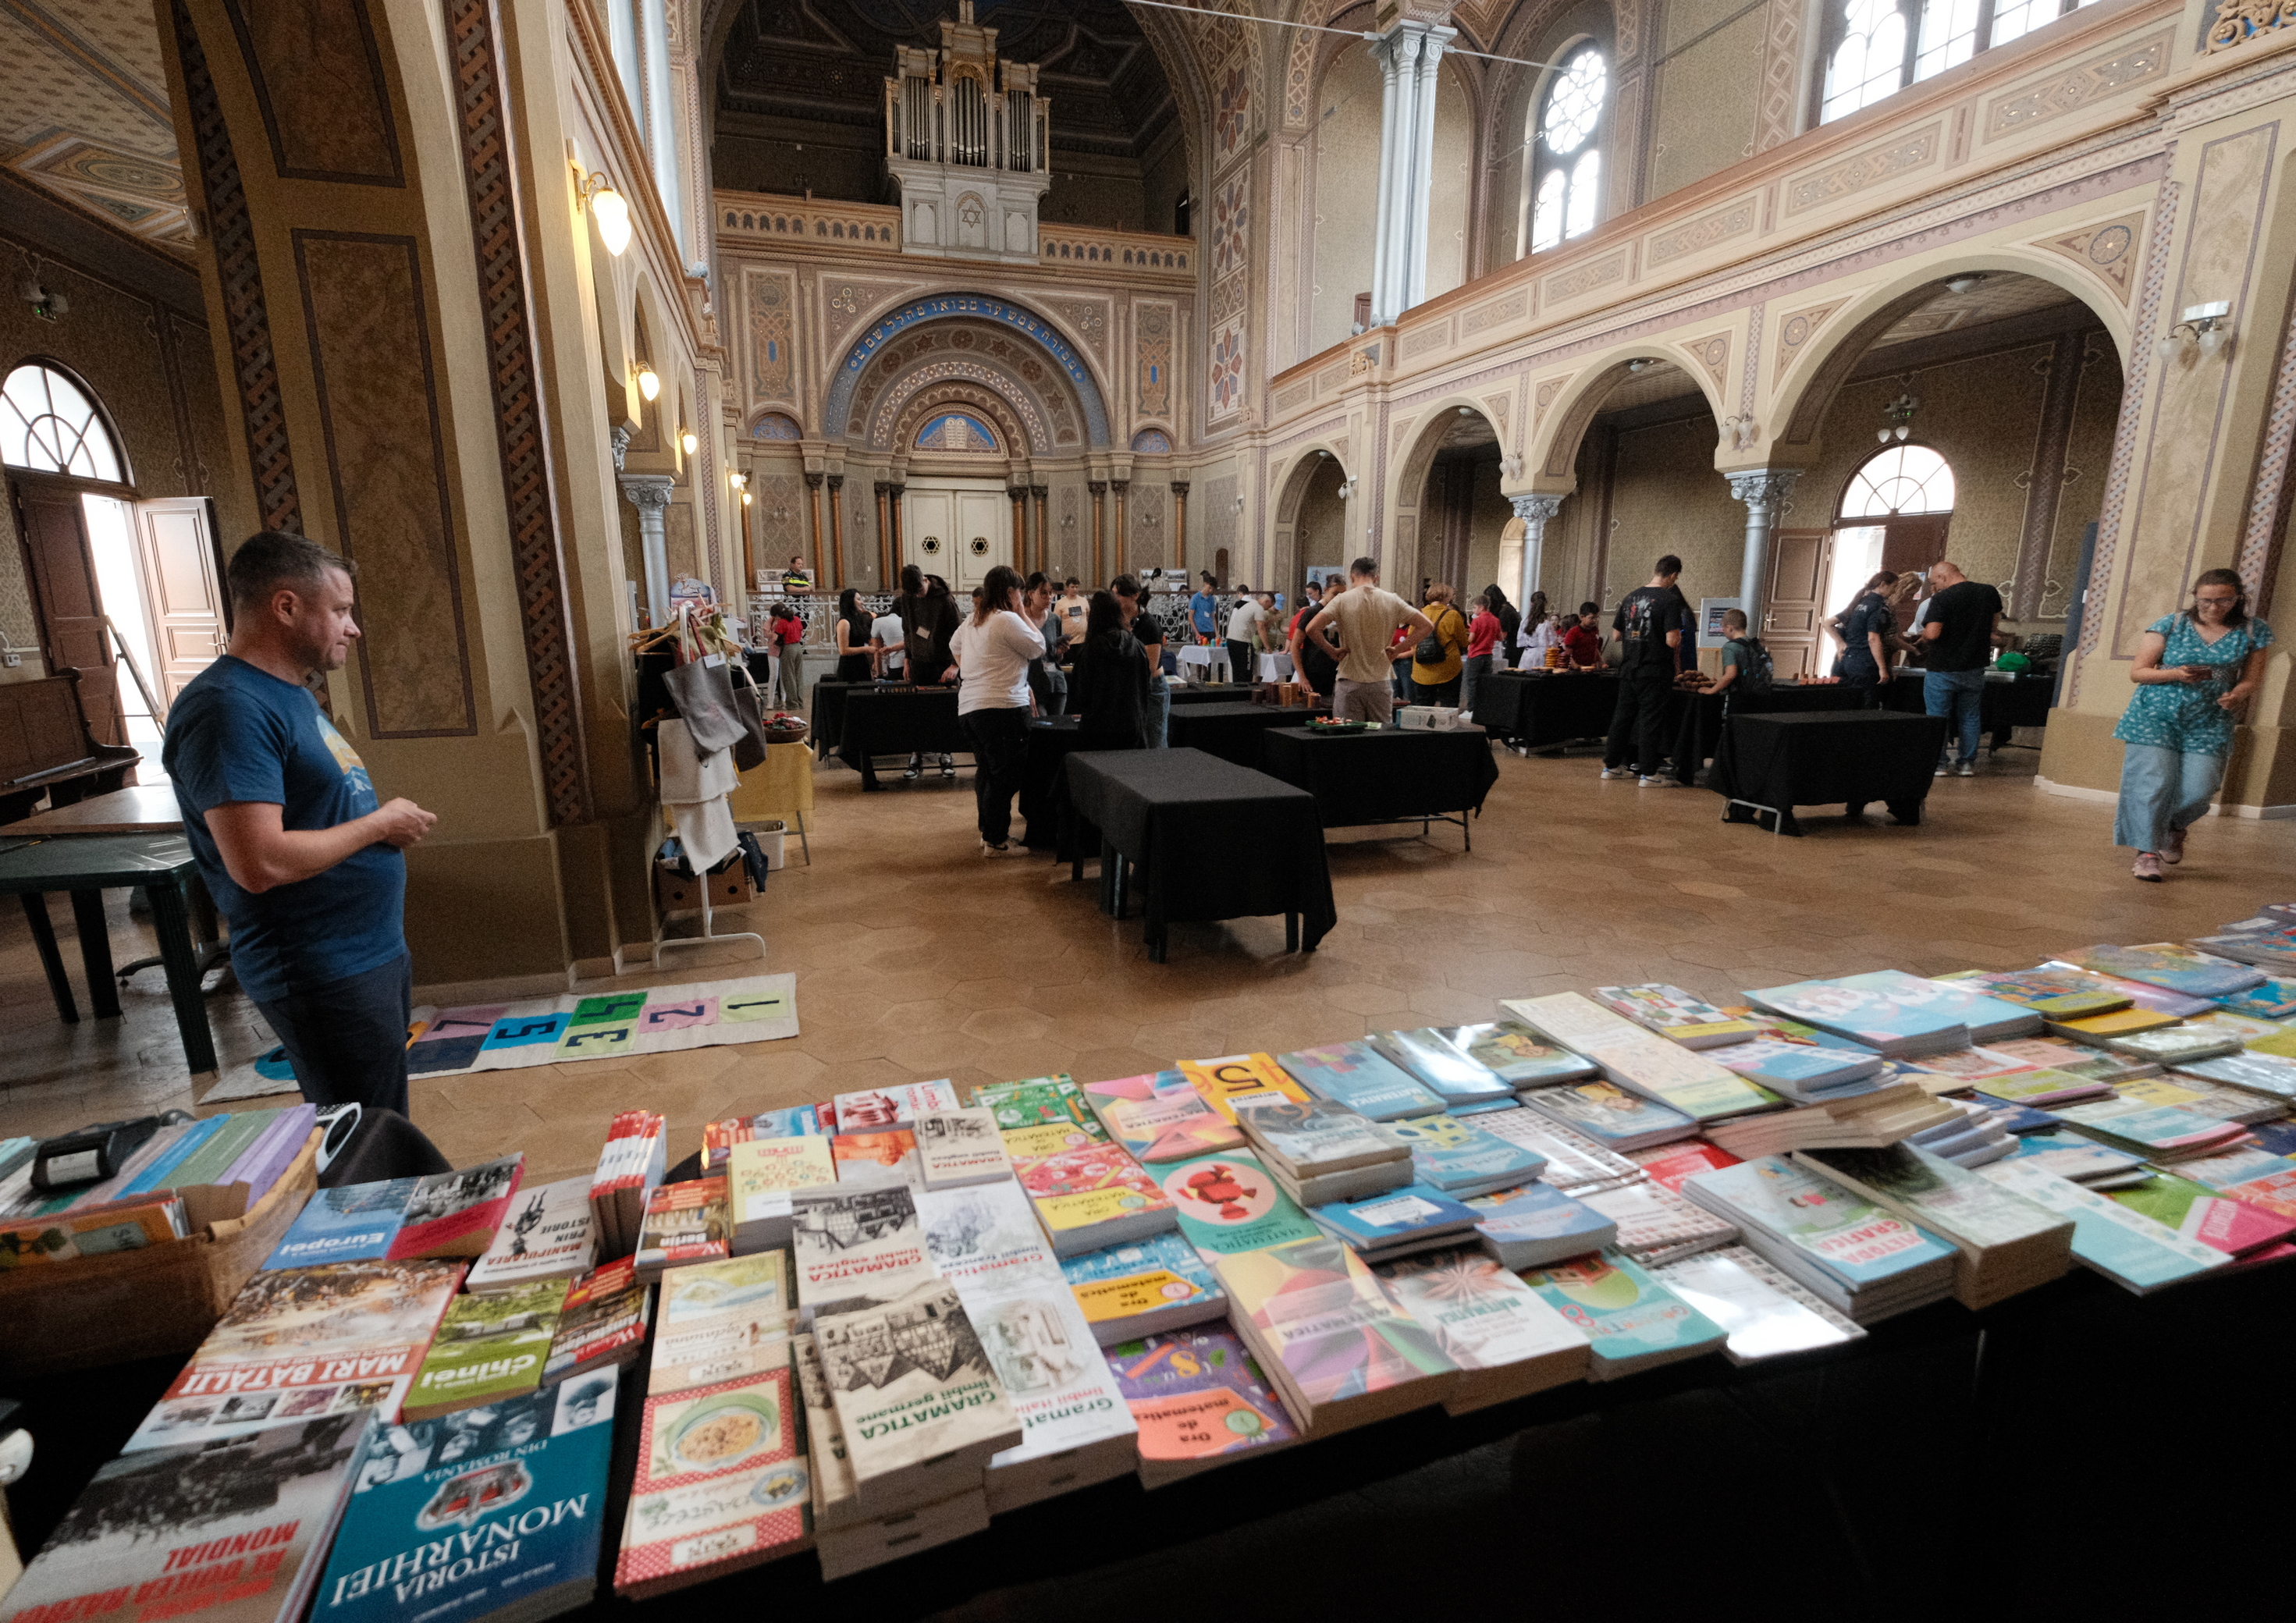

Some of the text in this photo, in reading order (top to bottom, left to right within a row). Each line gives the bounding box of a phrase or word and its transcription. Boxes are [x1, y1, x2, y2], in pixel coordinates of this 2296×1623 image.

[863, 329, 884, 350] שם
[432, 1018, 491, 1033] 7
[649, 1003, 706, 1024] 2
[495, 1020, 556, 1041] 5
[565, 1027, 629, 1049] 3
[1214, 1066, 1265, 1092] 5
[931, 1156, 1004, 1170] GRAMATICA
[539, 1216, 591, 1234] ISTORIE
[555, 1228, 585, 1243] PRIN
[280, 1231, 386, 1255] Europei
[659, 1232, 707, 1247] Berlin
[487, 1241, 582, 1266] MANIPULAREA
[807, 1246, 920, 1272] limbii engleze
[939, 1244, 1040, 1270] limbii franceze
[940, 1251, 1043, 1280] Gramatica
[808, 1254, 922, 1283] GRAMATICA
[1120, 1291, 1139, 1300] de
[1120, 1298, 1149, 1308] Ora
[549, 1312, 639, 1356] Amsterdam
[178, 1352, 408, 1397] MARI BĂTĂLII
[421, 1353, 538, 1387] Chinei
[855, 1378, 990, 1426] limbii germane
[1014, 1385, 1105, 1415] limbii itali
[858, 1390, 996, 1440] GRAMATICA
[1024, 1397, 1114, 1431] Gramat
[1178, 1419, 1199, 1429] de
[514, 1438, 549, 1459] DIN
[1179, 1431, 1211, 1443] Ora
[162, 1520, 300, 1574] MONDIAL
[329, 1492, 590, 1607] MONARHIEI
[393, 1540, 521, 1604] ISTORIA
